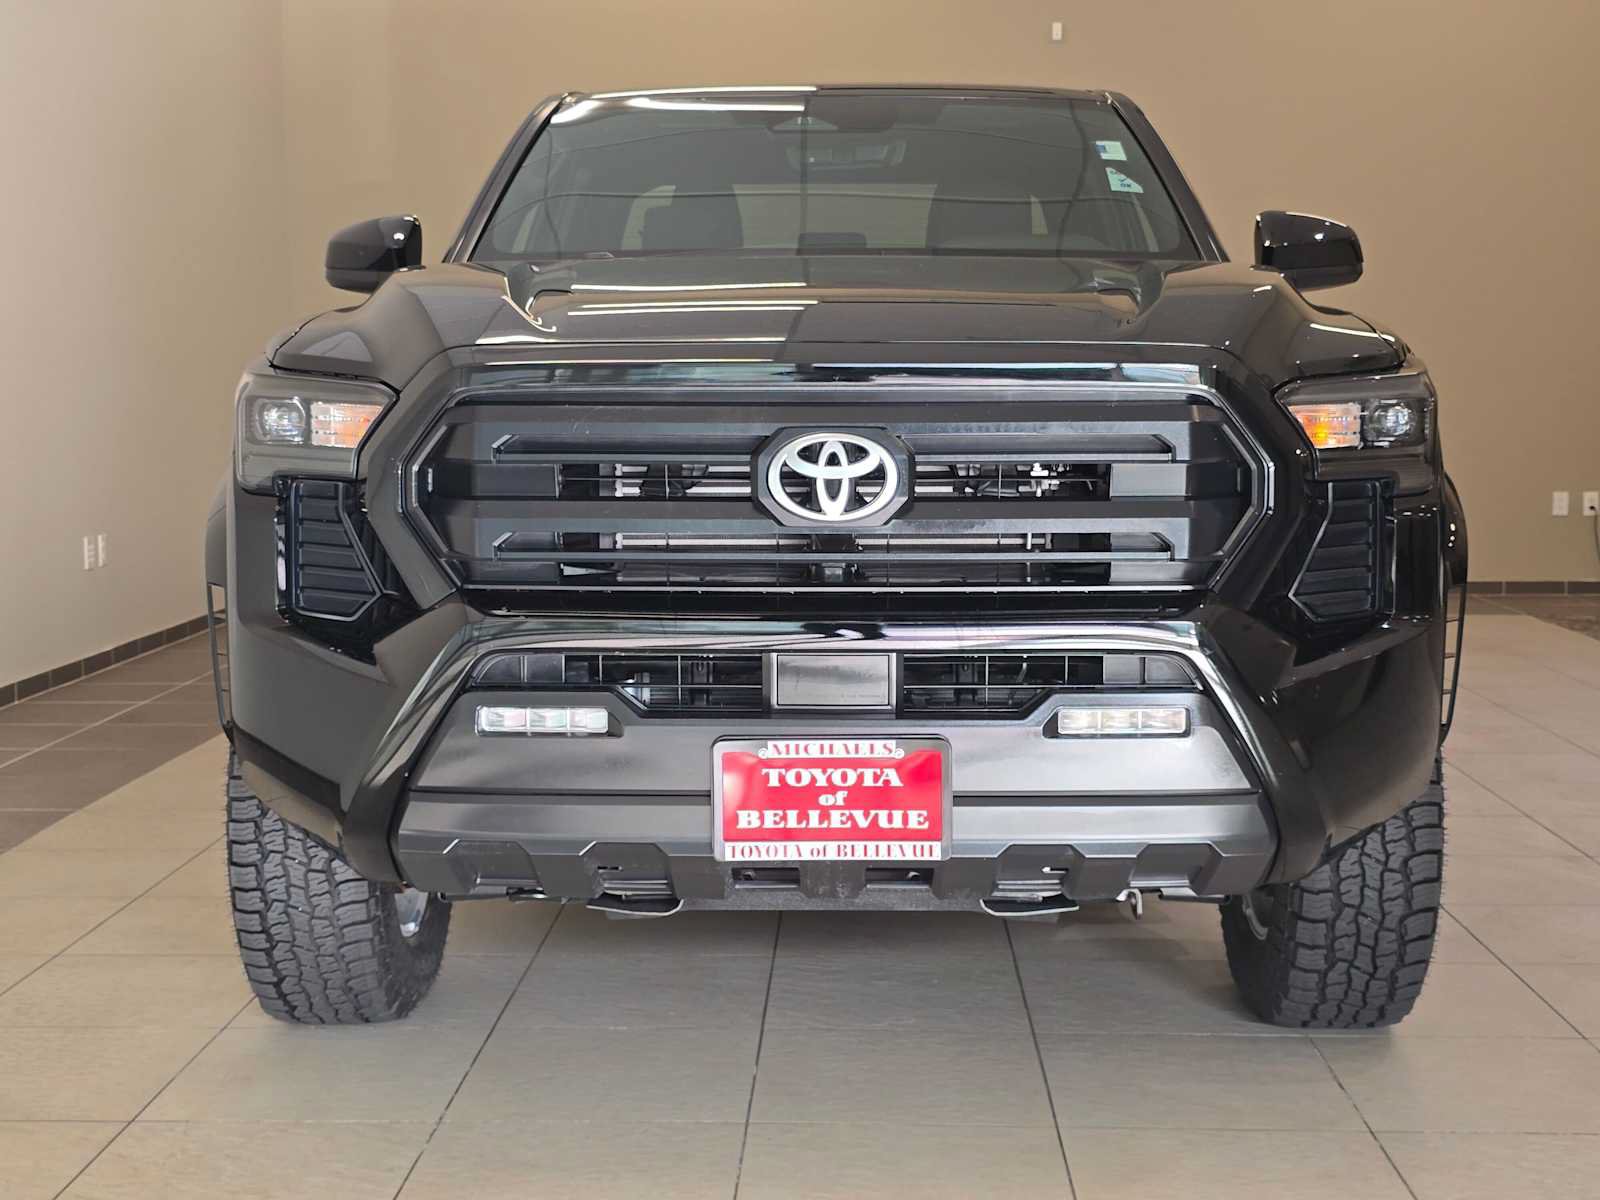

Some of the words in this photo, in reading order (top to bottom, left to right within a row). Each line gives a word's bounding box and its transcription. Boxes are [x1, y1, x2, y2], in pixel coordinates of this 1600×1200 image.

[761, 767, 904, 787] TOYOTA
[817, 790, 848, 806] of
[735, 809, 929, 829] BELLEVUE
[727, 843, 804, 859] TOYOTA
[810, 843, 828, 859] of
[836, 843, 940, 859] BELLEVUE
